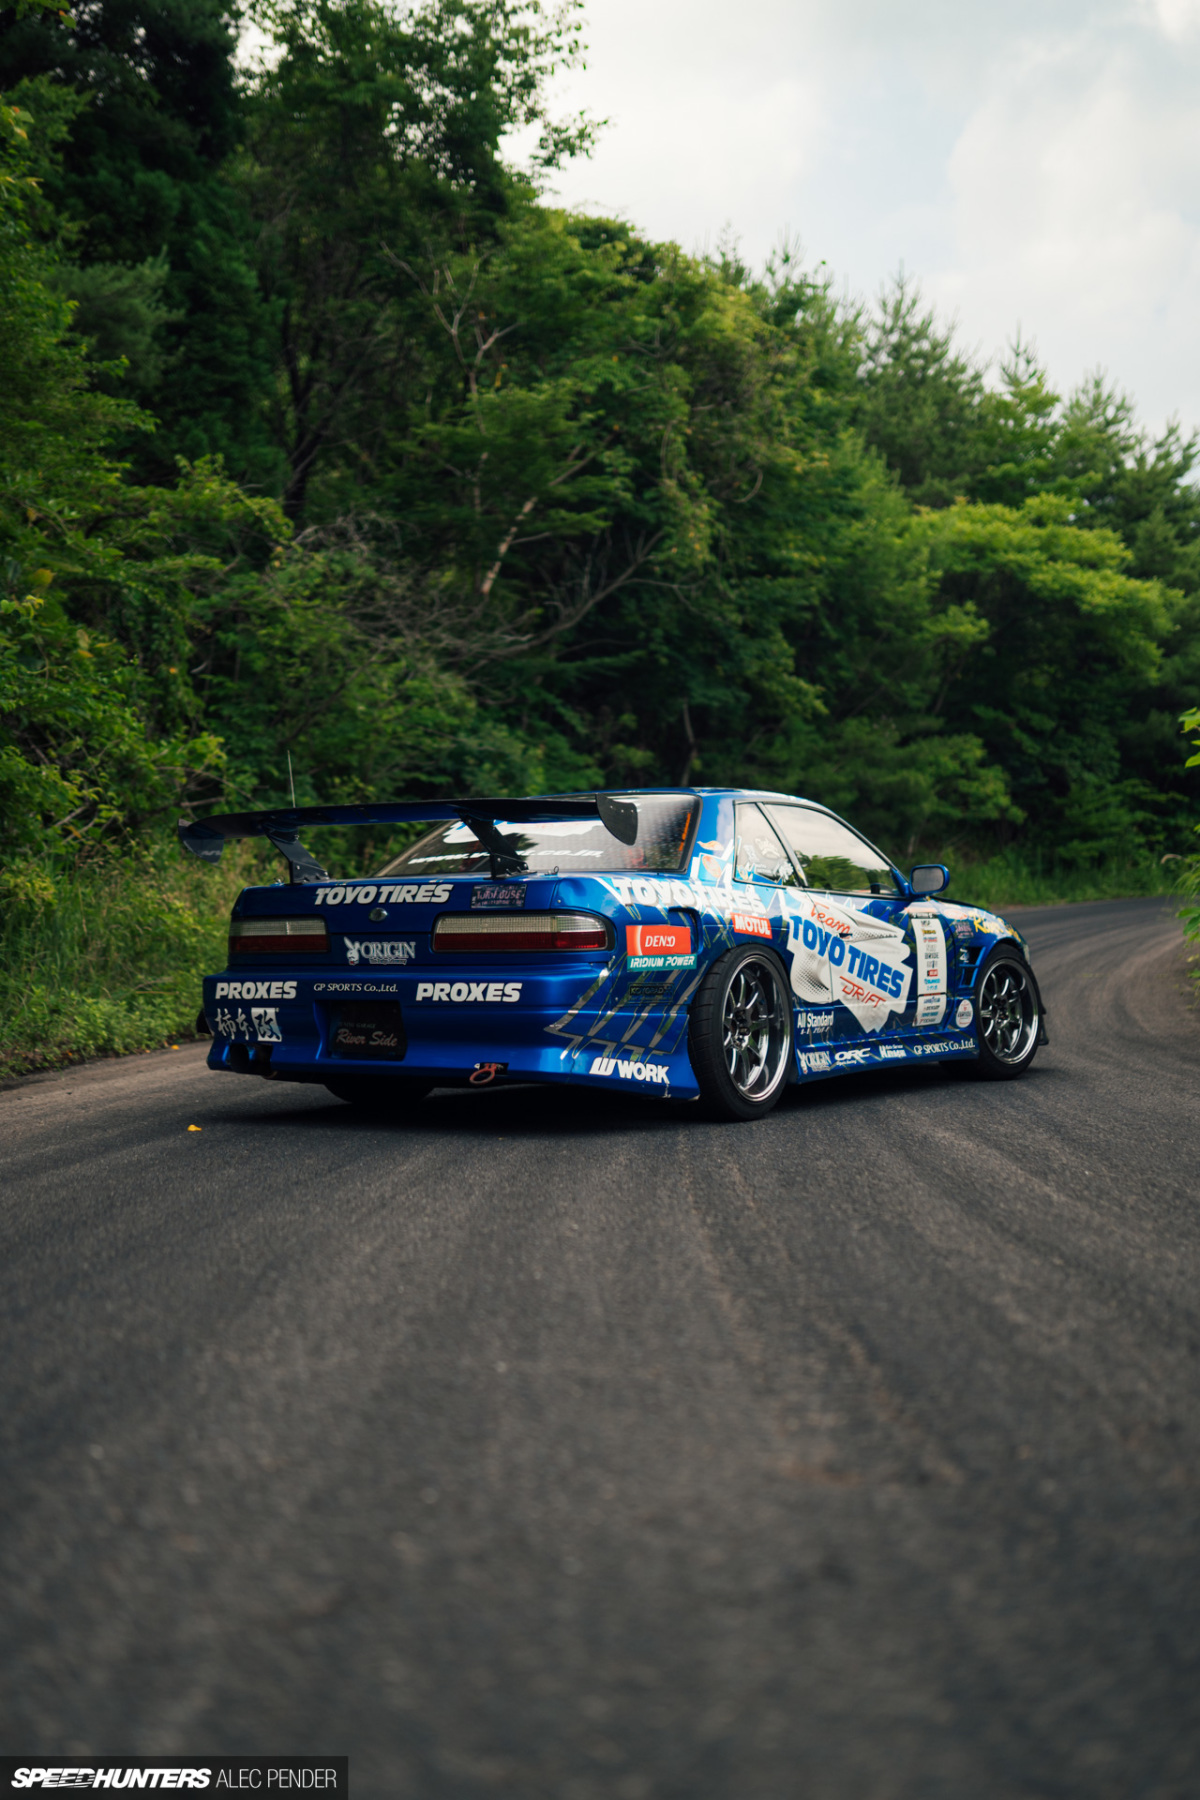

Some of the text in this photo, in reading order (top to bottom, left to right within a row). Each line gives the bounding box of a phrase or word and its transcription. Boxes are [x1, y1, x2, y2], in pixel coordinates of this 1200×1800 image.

[314, 884, 454, 905] TOYO TIRES
[613, 878, 767, 916] TOYO TIRES
[733, 915, 771, 936] MOTUL
[810, 902, 851, 934] Team
[360, 941, 416, 959] ORIGIN
[789, 915, 905, 999] TOYO TIRES
[630, 956, 695, 968] IRIDIUM POWER
[215, 981, 298, 1000] PROXES
[313, 983, 326, 992] GP
[326, 983, 362, 992] SPORTS
[415, 982, 523, 1003] PROXES
[839, 976, 887, 1008] DRIFT
[797, 1010, 834, 1029] All Standard
[336, 1028, 398, 1047] River Side
[834, 1048, 871, 1064] ORC
[913, 1045, 923, 1055] GP
[923, 1042, 949, 1054] SPORTS
[806, 1051, 832, 1066] ORIGIN
[616, 1059, 670, 1084] WORK
